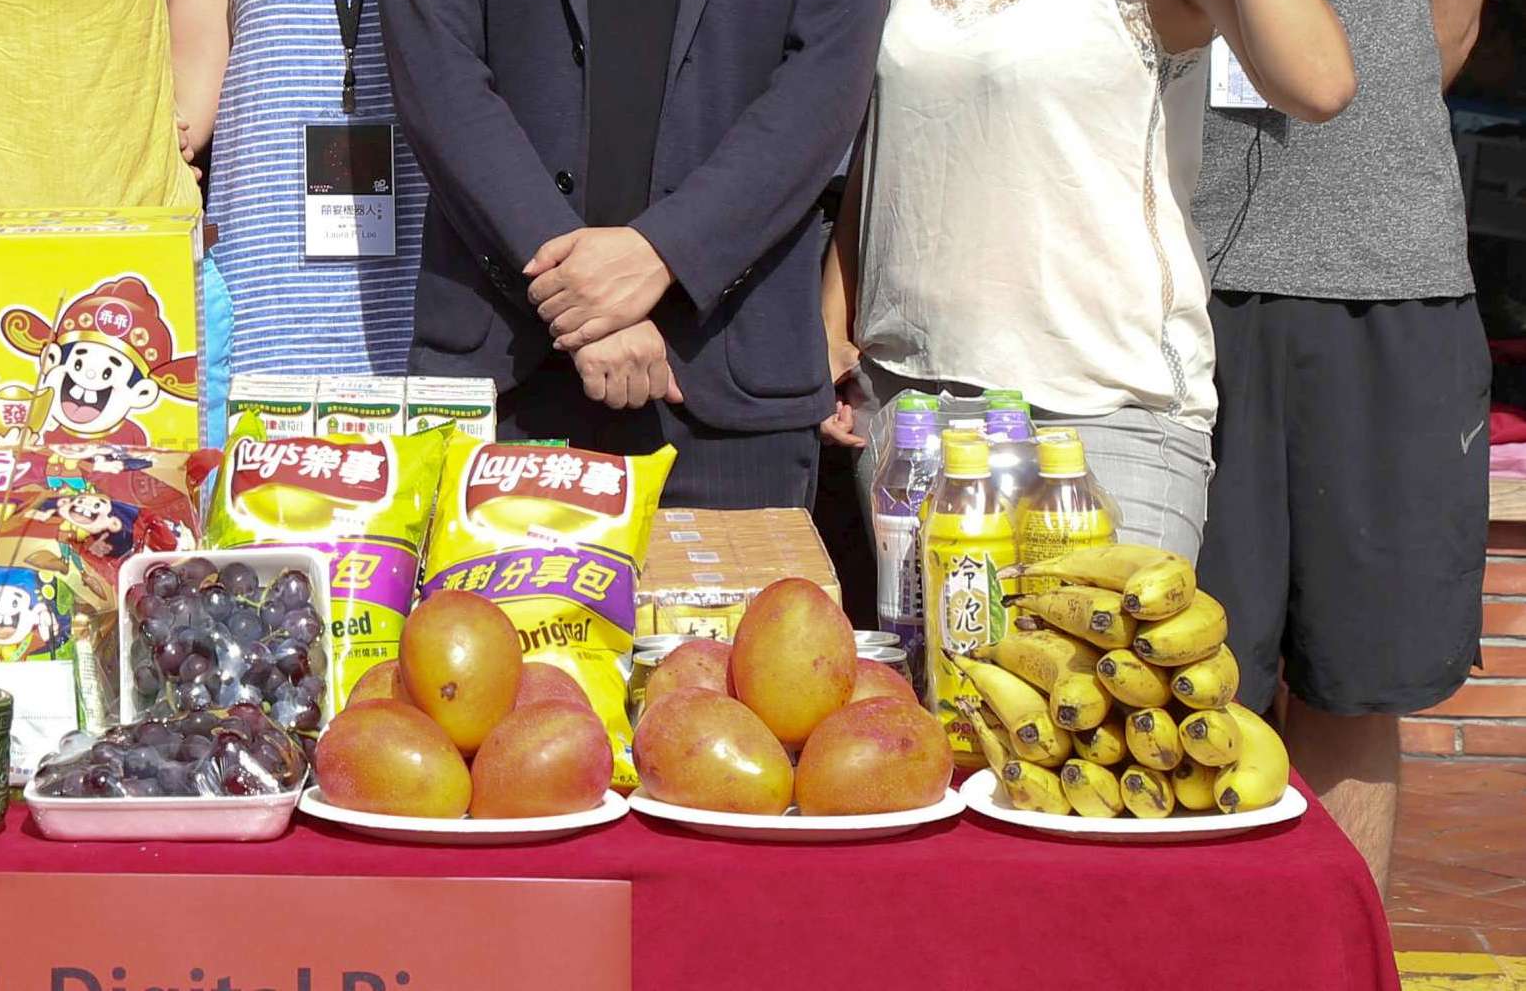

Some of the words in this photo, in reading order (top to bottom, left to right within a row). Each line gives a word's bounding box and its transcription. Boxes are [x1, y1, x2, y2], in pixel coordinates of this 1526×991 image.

[99, 309, 130, 329] 乖乖
[3, 403, 27, 425] 發
[237, 439, 304, 478] Lay's
[299, 444, 386, 485] 樂事
[469, 453, 542, 492] Lay's
[538, 453, 625, 496] 樂事
[442, 554, 618, 602] 派對分享包
[951, 554, 984, 651] 冷泡
